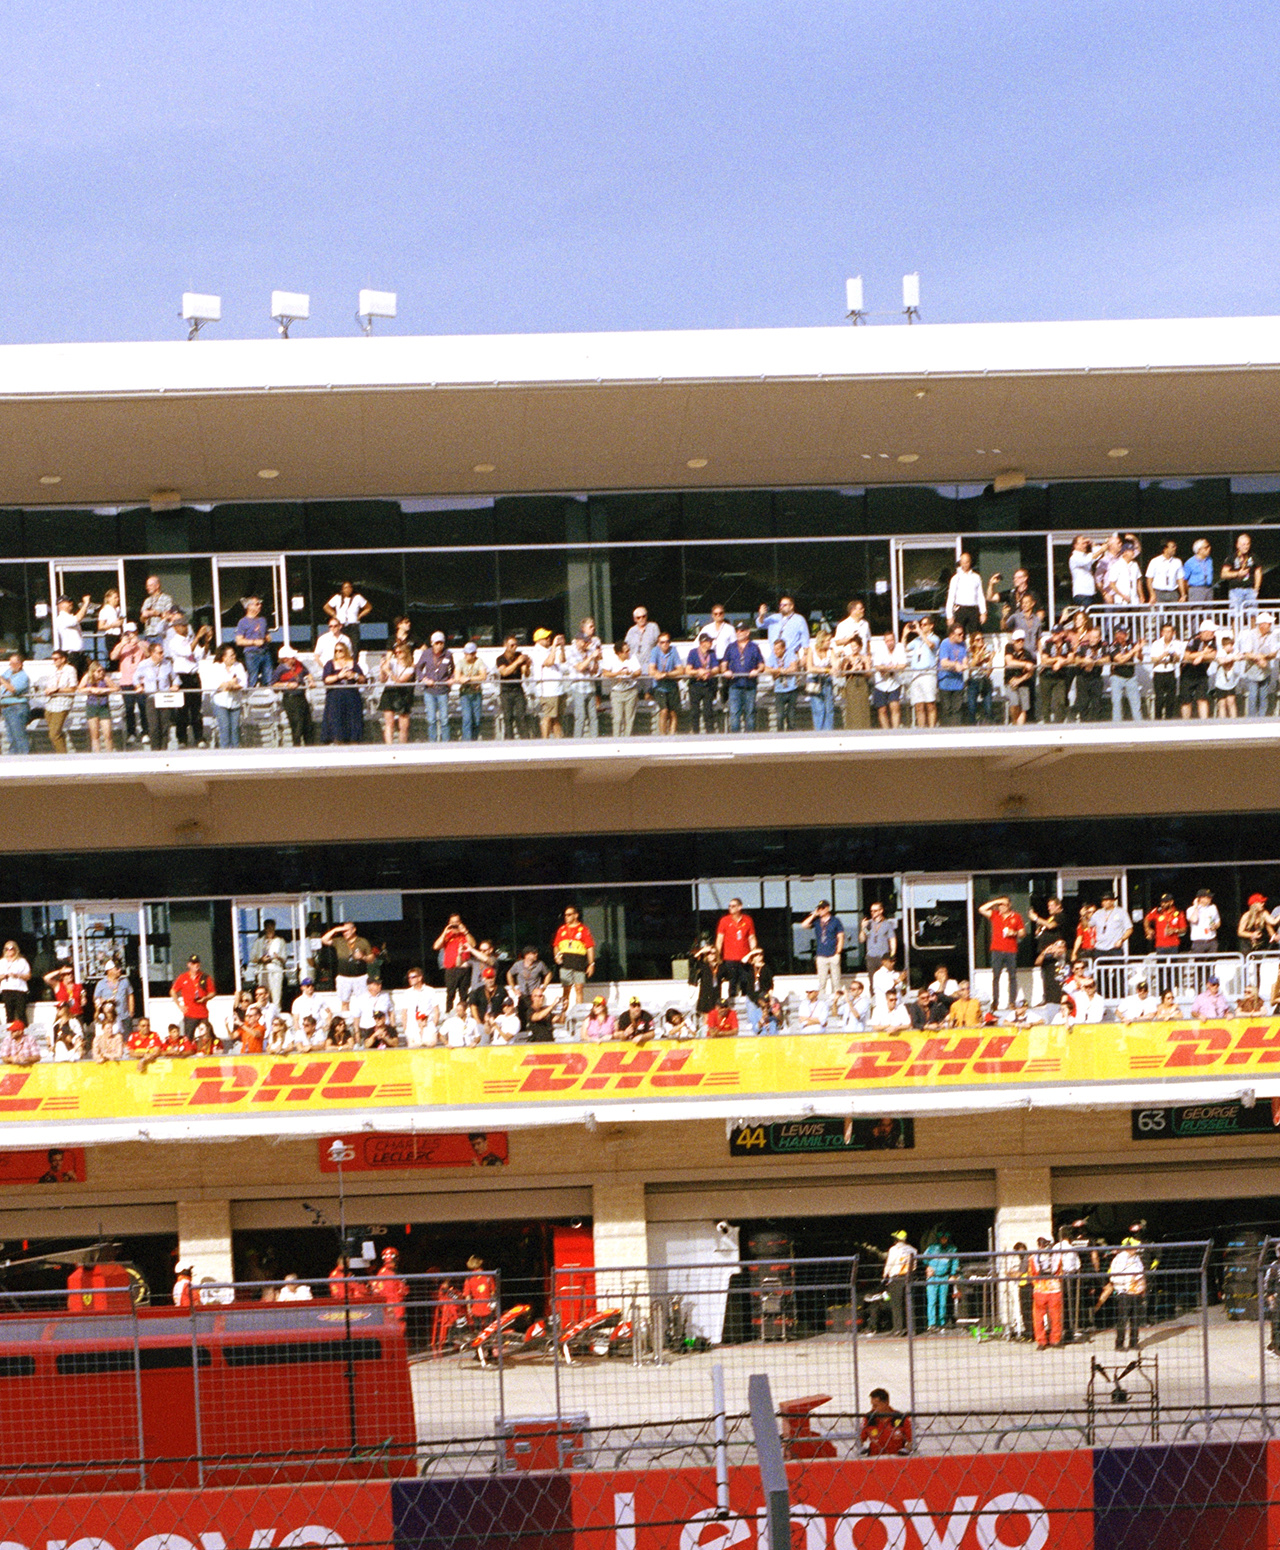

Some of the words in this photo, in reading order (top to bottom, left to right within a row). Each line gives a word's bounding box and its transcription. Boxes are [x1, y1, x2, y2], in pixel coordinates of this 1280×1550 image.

[844, 1035, 1030, 1079] DHL
[518, 1048, 706, 1093] DHL
[189, 1060, 379, 1106] DHL
[1137, 1110, 1166, 1131] 63
[1182, 1106, 1239, 1119] GEORGE
[781, 1122, 826, 1137] LEWIS
[1179, 1118, 1239, 1131] RUSSELL
[736, 1127, 767, 1149] 44
[372, 1150, 435, 1163] LECLERC
